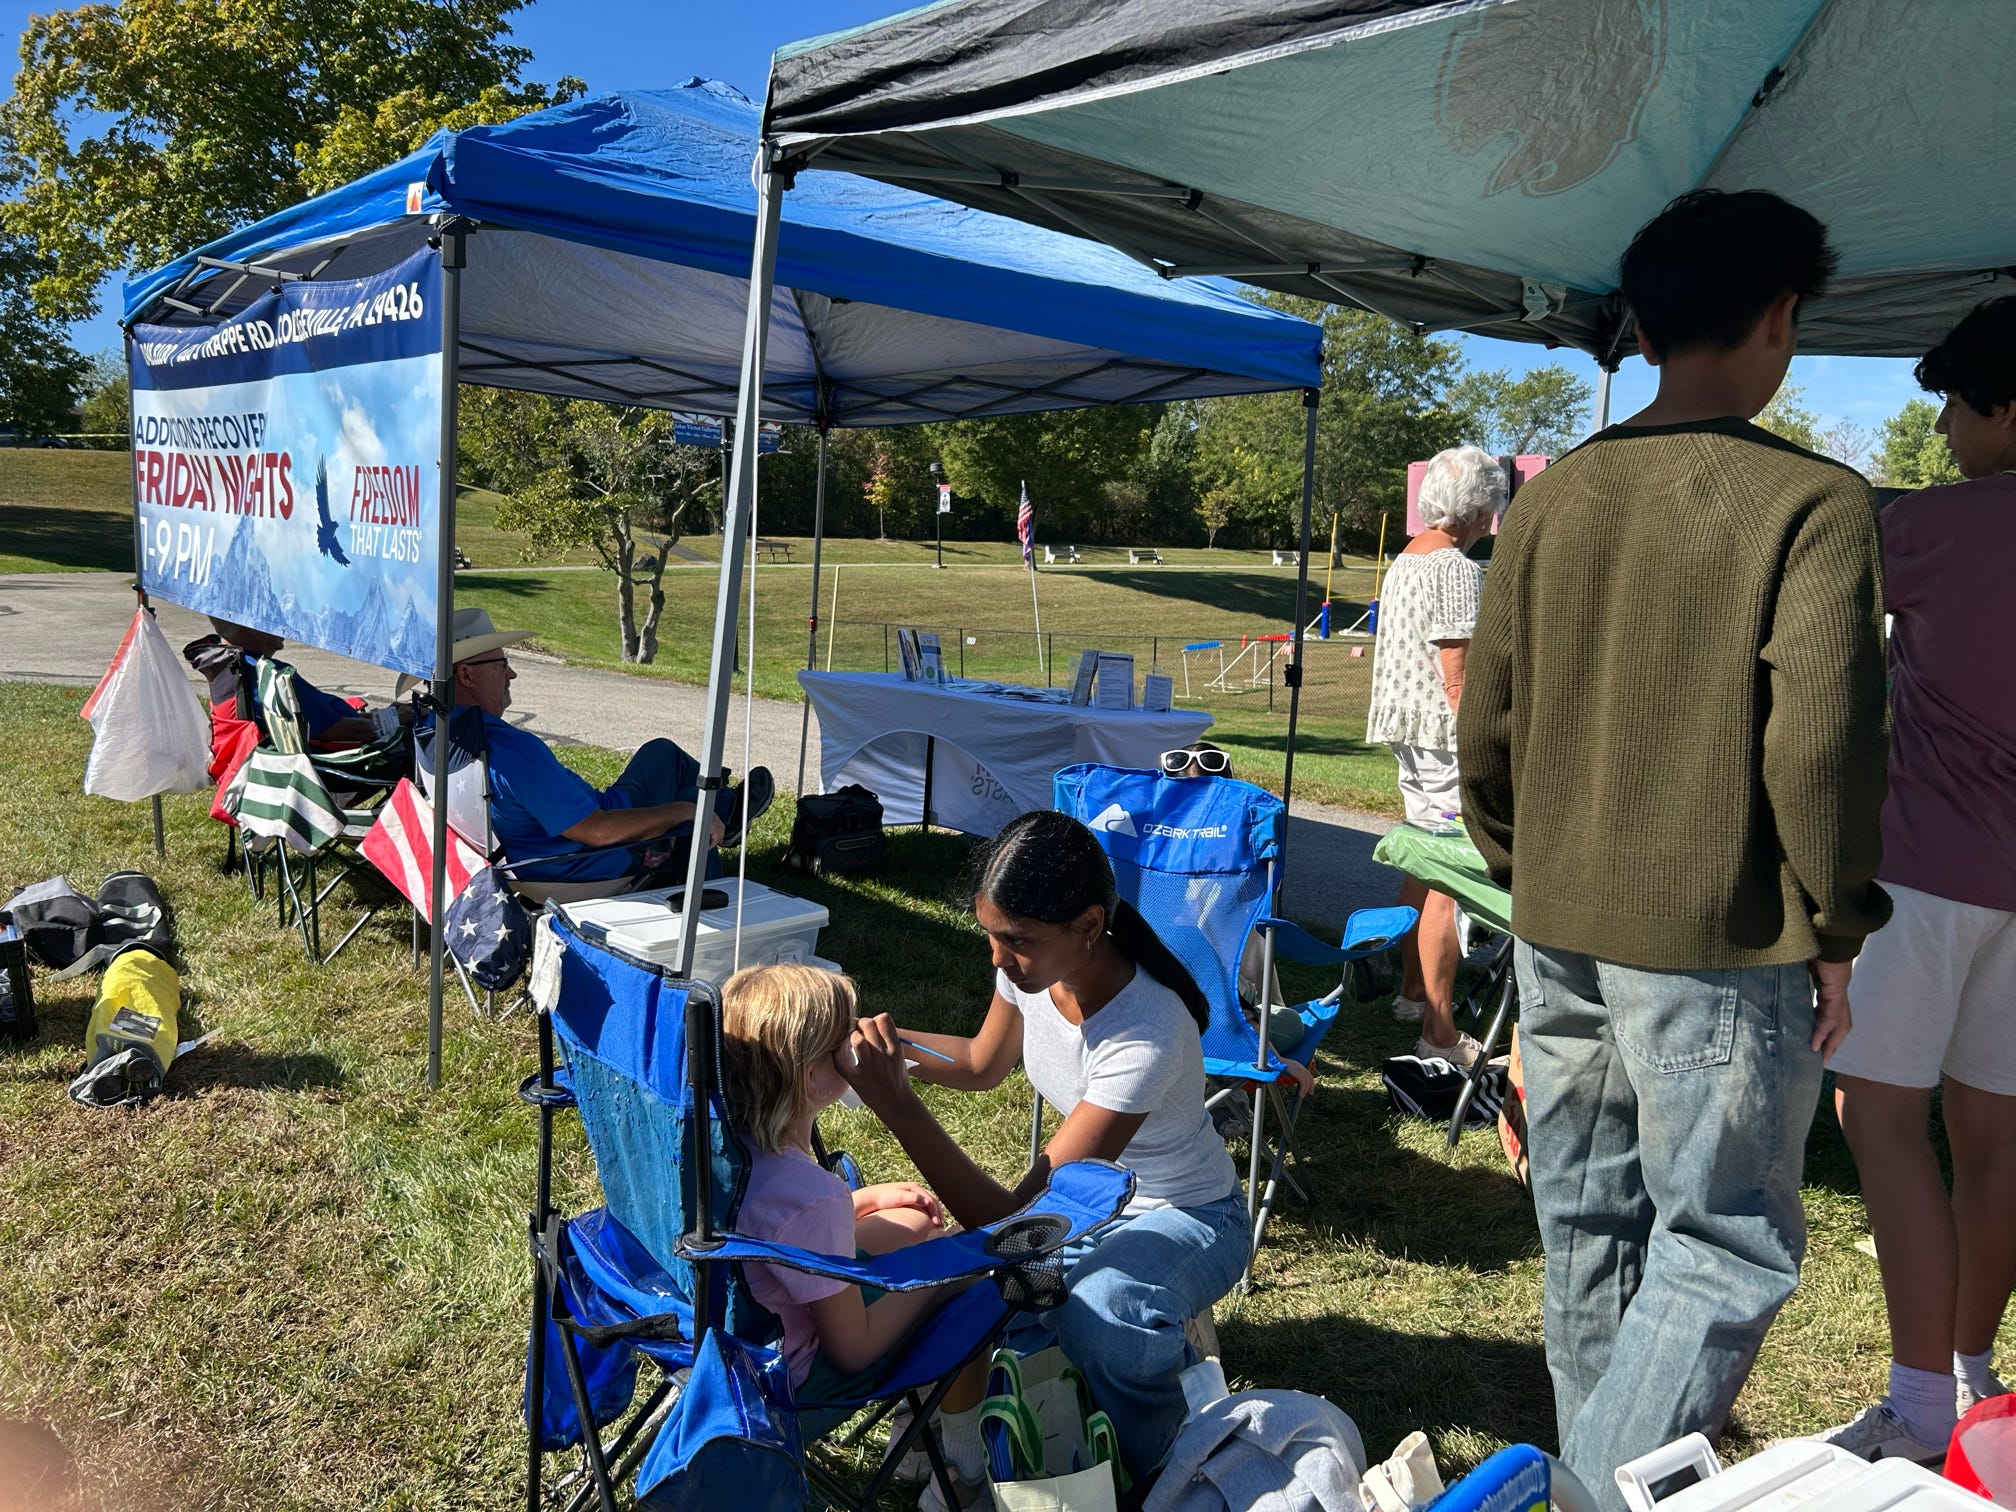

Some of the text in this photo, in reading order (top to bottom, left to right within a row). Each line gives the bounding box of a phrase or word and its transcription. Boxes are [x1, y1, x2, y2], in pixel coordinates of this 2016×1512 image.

[364, 282, 424, 326] 19426
[136, 450, 294, 520] FRIDAY NIGHTS
[350, 465, 419, 527] FREEDOM
[173, 522, 215, 587] PM
[349, 524, 382, 557] THAT
[1142, 823, 1191, 839] OZARK
